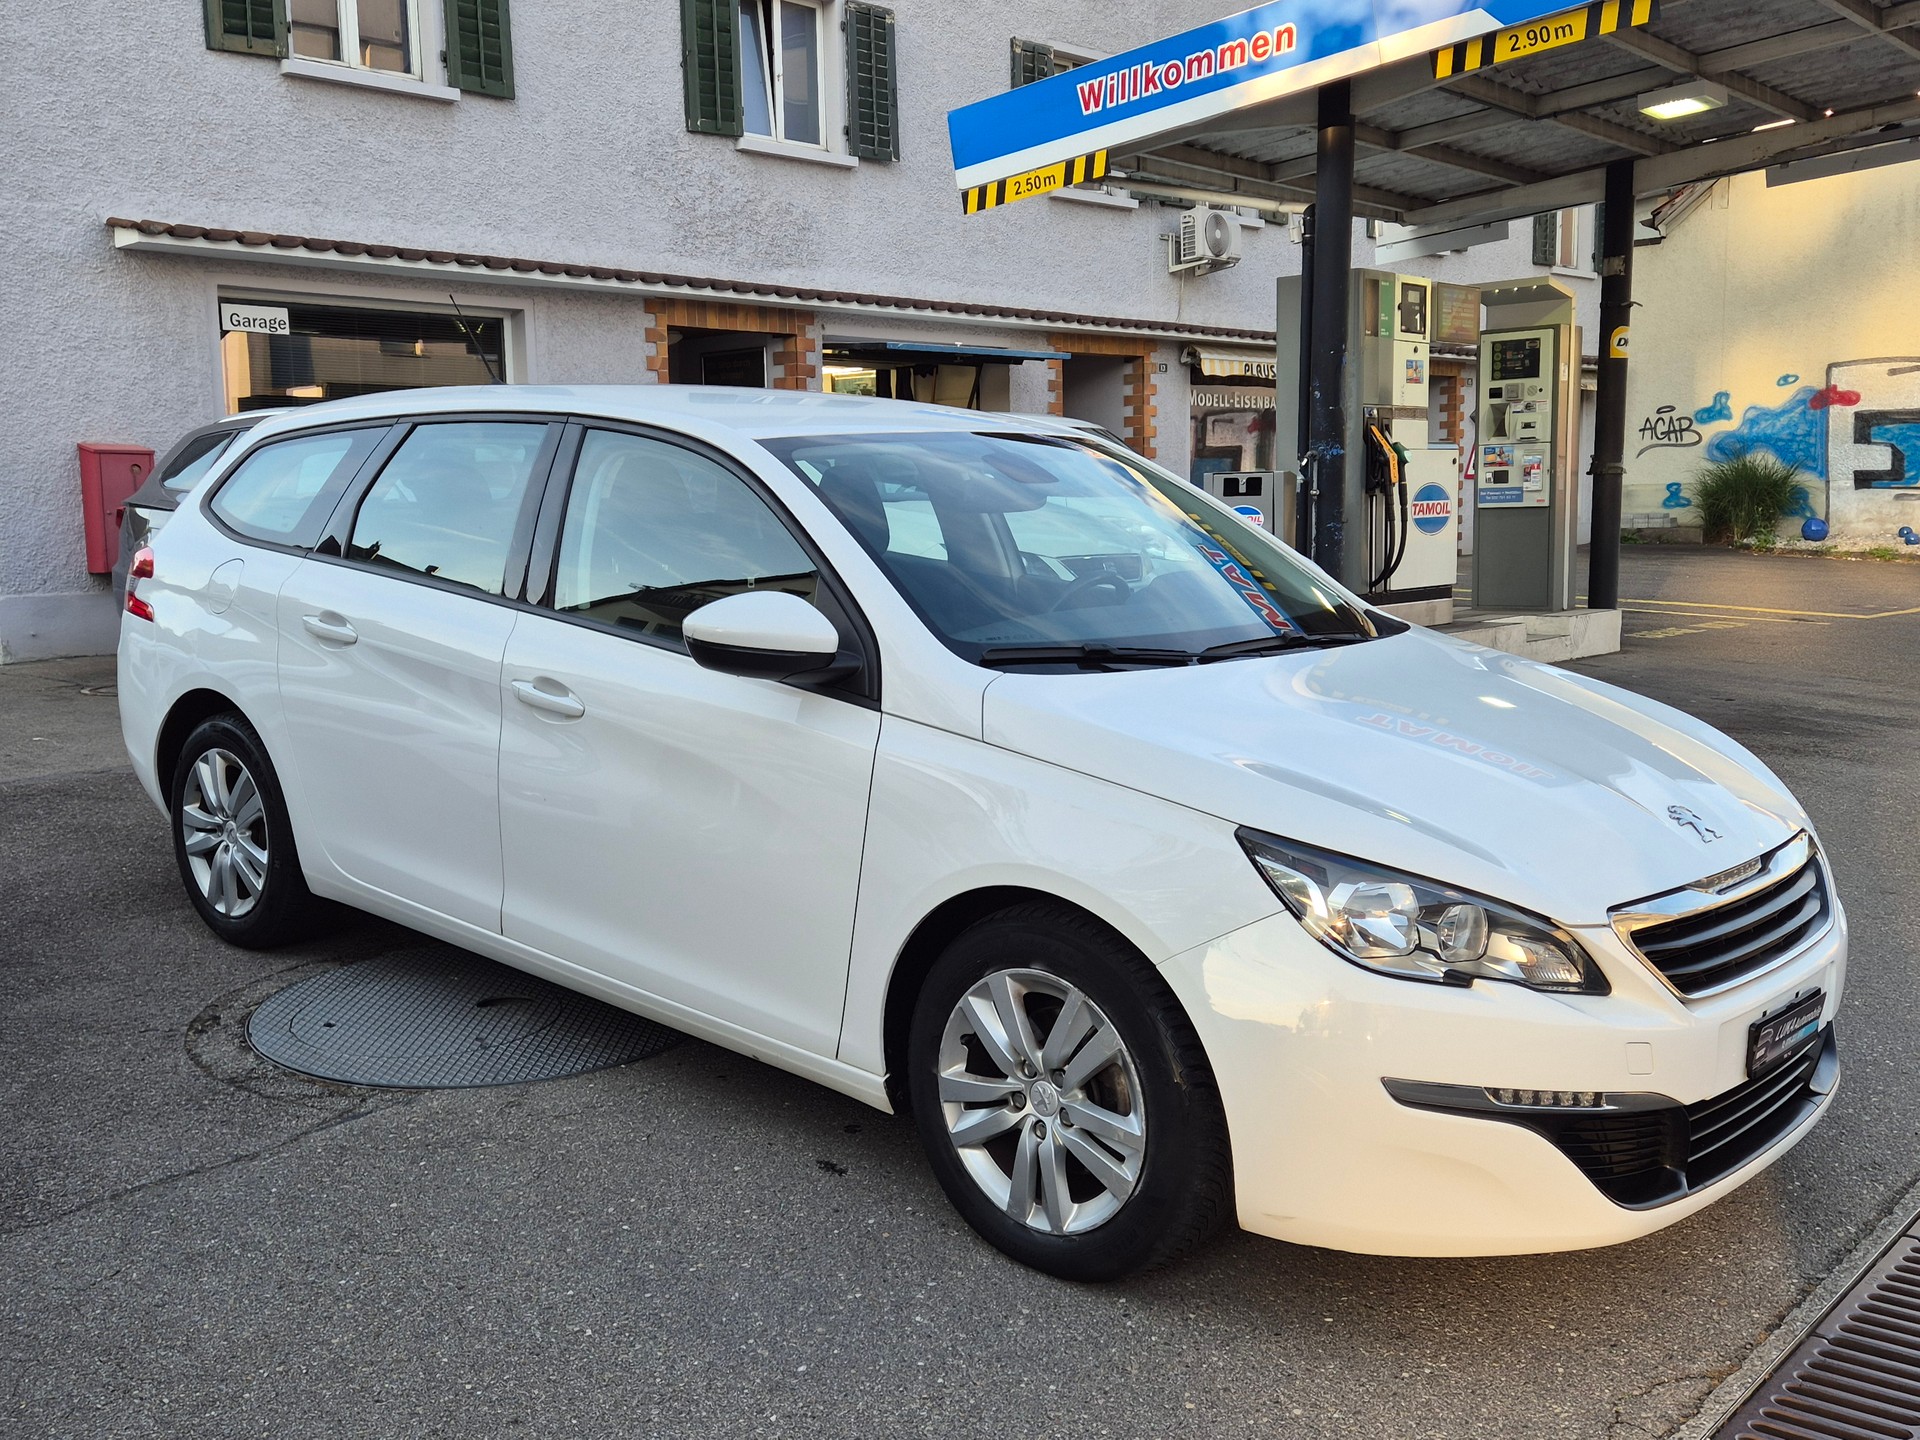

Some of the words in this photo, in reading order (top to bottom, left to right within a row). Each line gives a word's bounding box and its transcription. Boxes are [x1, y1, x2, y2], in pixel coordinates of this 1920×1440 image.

[1508, 26, 1551, 52] 2.90
[1078, 23, 1295, 114] Willkommen
[229, 312, 287, 333] Garage
[1412, 502, 1451, 516] TAMOIL
